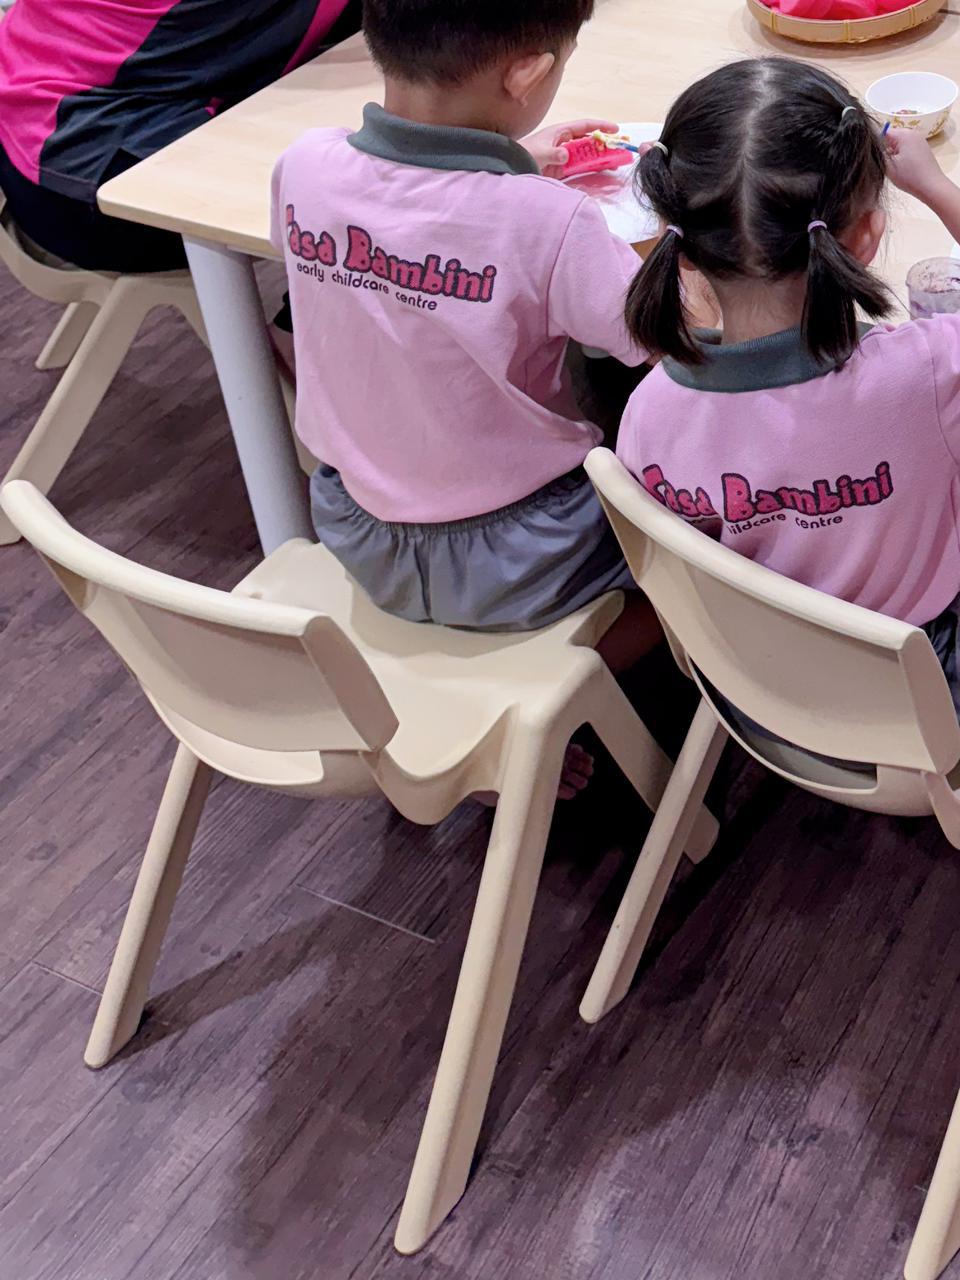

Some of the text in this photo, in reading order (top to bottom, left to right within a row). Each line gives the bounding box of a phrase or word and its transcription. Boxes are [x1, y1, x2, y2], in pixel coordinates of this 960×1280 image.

[296, 261, 438, 311] early childcare centre
[343, 225, 497, 303] Bambini
[721, 461, 894, 523] Bambini
